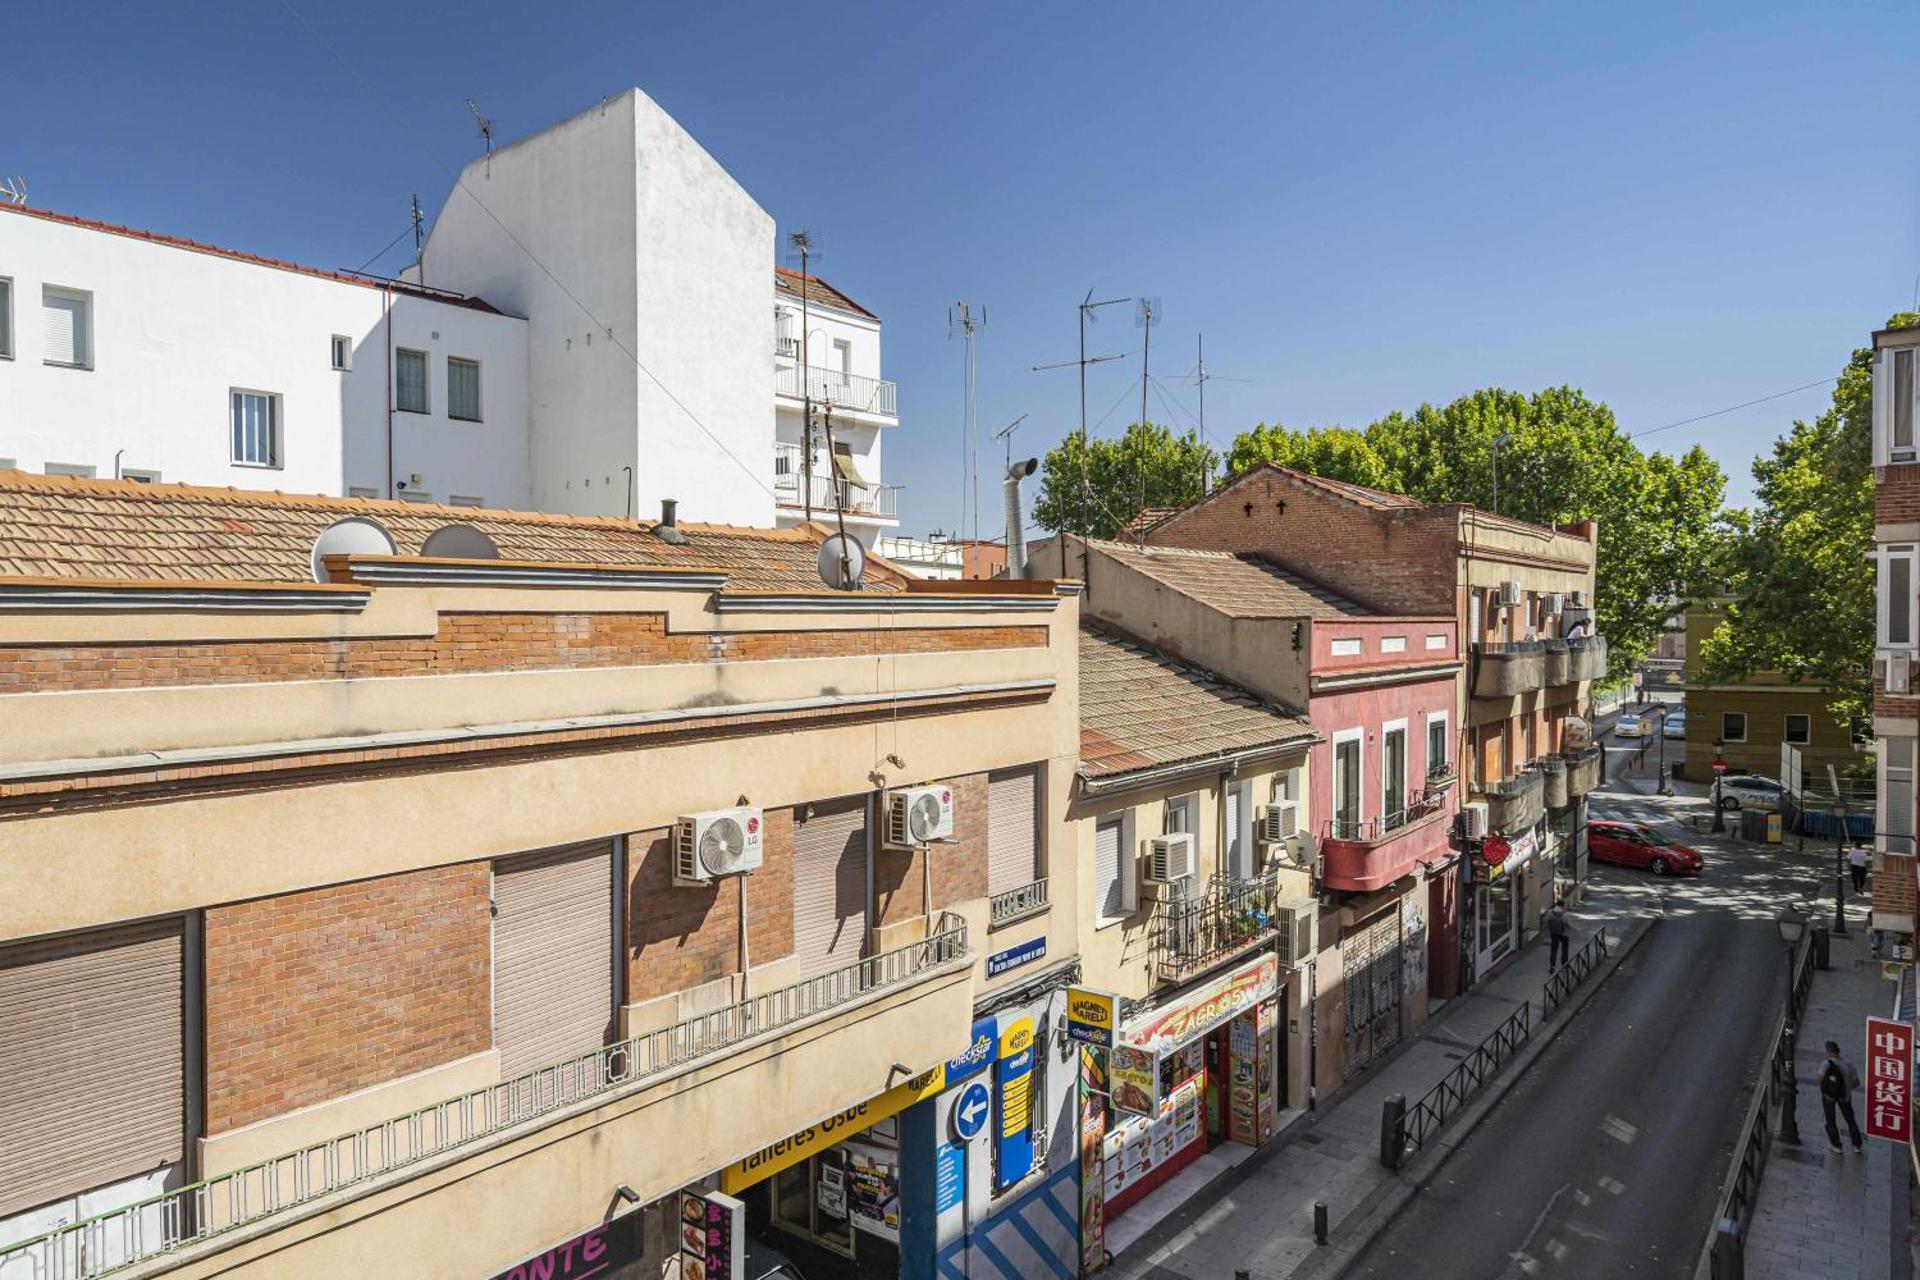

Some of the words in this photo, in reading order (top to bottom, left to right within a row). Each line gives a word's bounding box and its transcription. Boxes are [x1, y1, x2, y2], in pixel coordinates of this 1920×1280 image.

[942, 805, 951, 814] LG
[748, 834, 759, 847] LG
[1873, 1031, 1906, 1132] 中国货行
